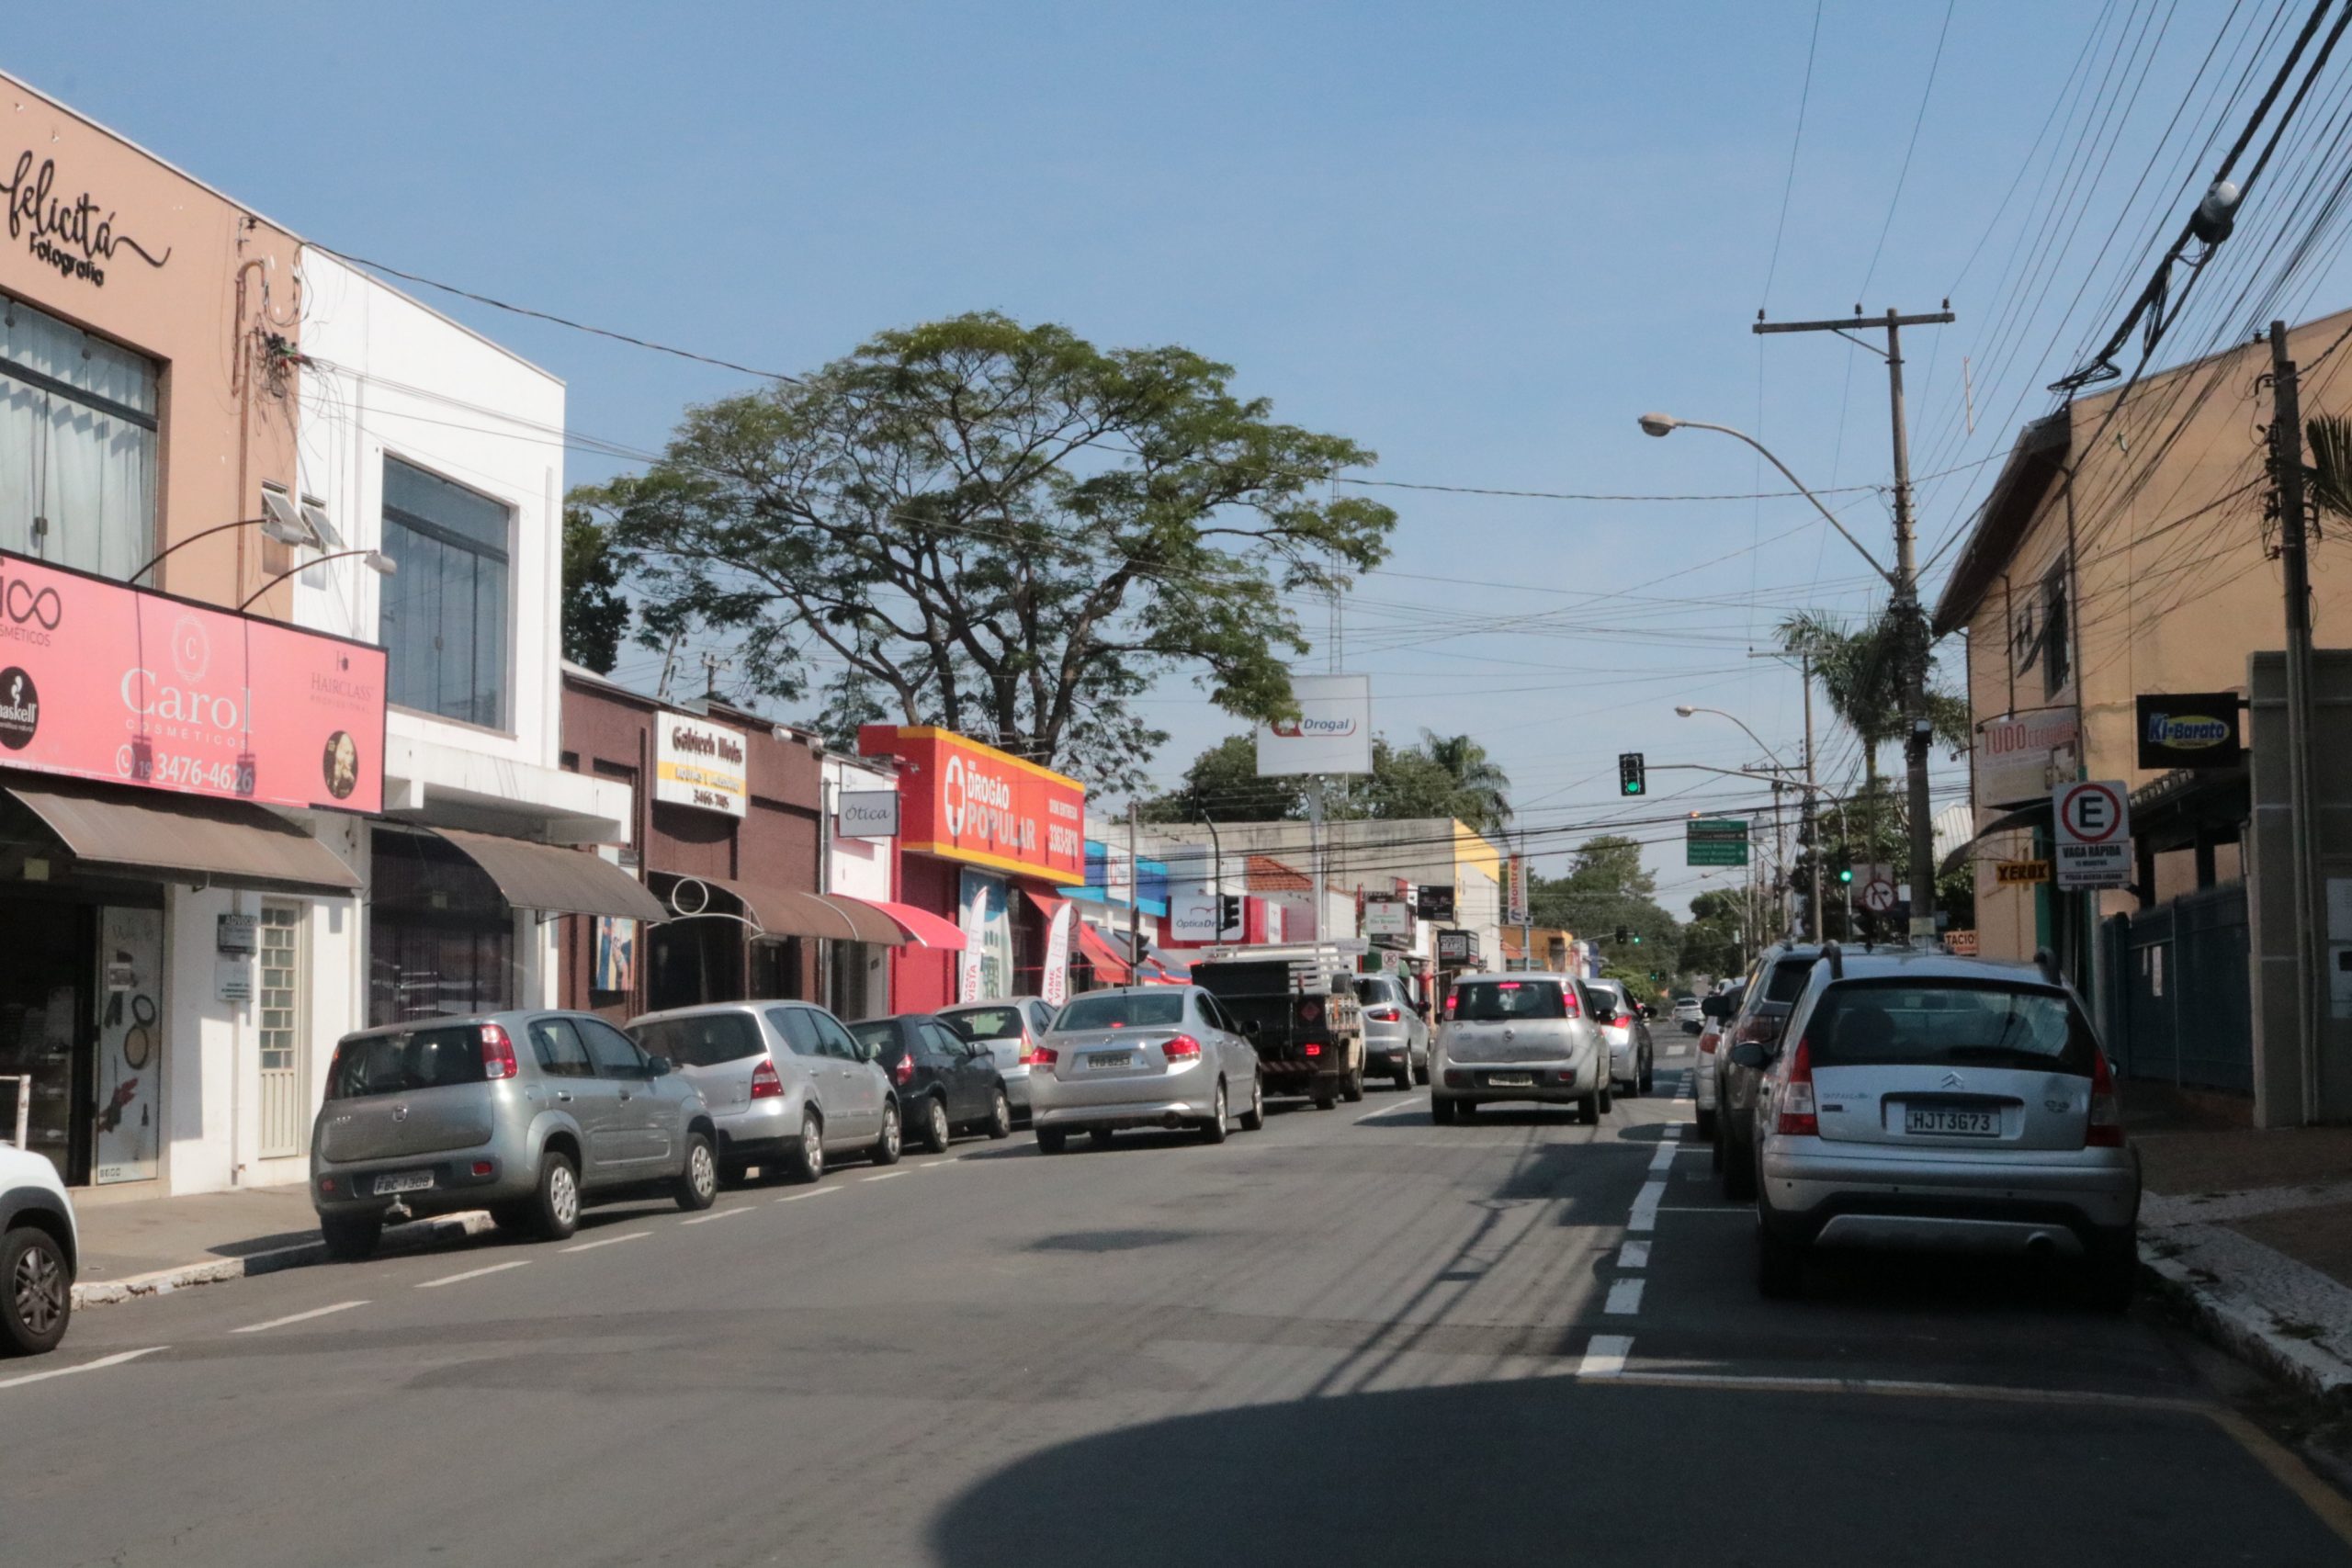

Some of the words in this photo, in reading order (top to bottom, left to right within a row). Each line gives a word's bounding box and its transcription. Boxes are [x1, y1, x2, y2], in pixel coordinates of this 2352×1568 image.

[120, 667, 254, 734] Carol
[1303, 718, 1350, 731] Drogal
[1984, 724, 2026, 755] TUDO
[2149, 713, 2225, 742] Ki-Barato
[139, 760, 153, 778] 19
[156, 752, 254, 793] 3476-4626
[967, 771, 1010, 810] DROGÃO
[844, 804, 889, 820] Ótica
[967, 801, 1036, 851] POPULAR
[2078, 796, 2105, 829] E
[2063, 846, 2086, 859] VAGA
[1997, 863, 2047, 881] XEROX
[1047, 970, 1056, 1005] XAME
[1054, 965, 1063, 1000] VISTA
[1913, 1112, 1991, 1132] HJT3G73
